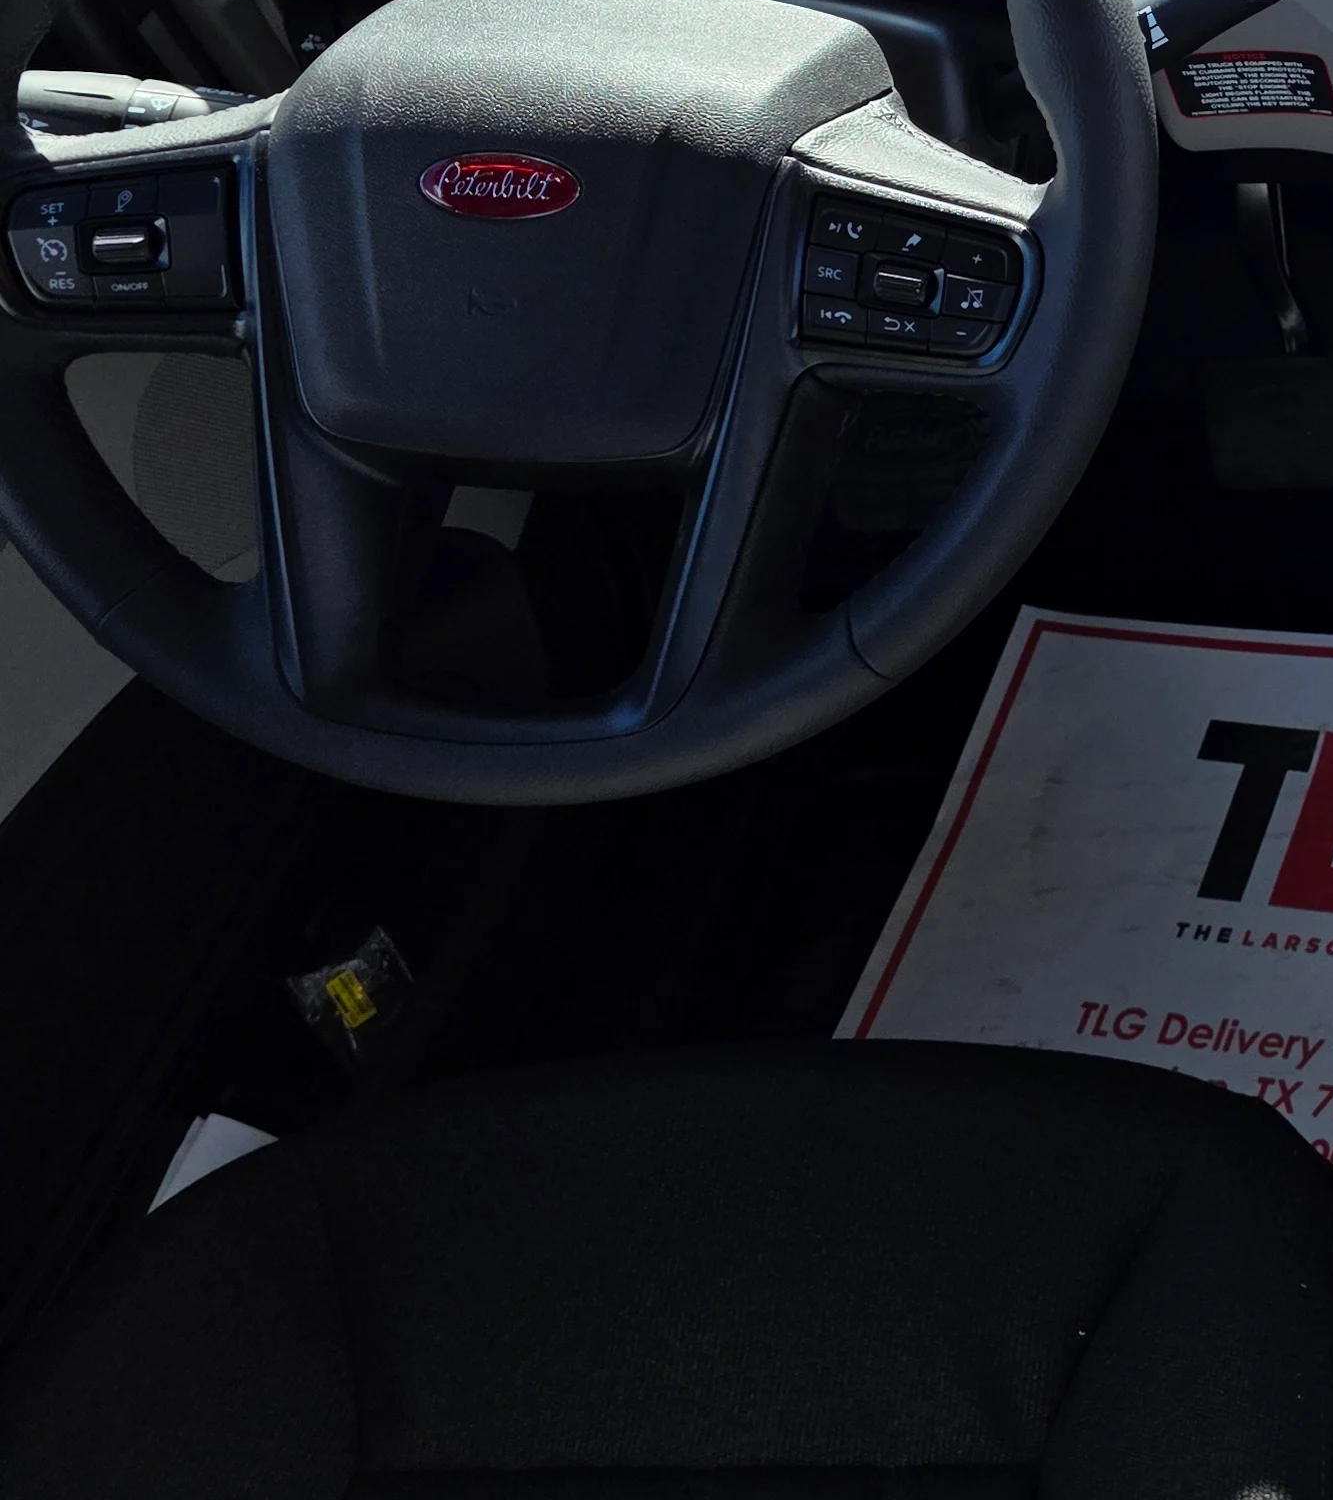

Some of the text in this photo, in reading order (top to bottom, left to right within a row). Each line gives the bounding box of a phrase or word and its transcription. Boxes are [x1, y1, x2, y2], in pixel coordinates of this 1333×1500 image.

[435, 161, 565, 200] Peterbilt
[40, 202, 65, 215] SET
[817, 266, 843, 281] SRC
[49, 278, 76, 290] RES
[111, 282, 149, 291] ON/OFF
[1176, 922, 1234, 944] THE
[1076, 1001, 1148, 1041] TLG
[1157, 1012, 1326, 1071] Delivery
[1256, 1078, 1303, 1114] TX
